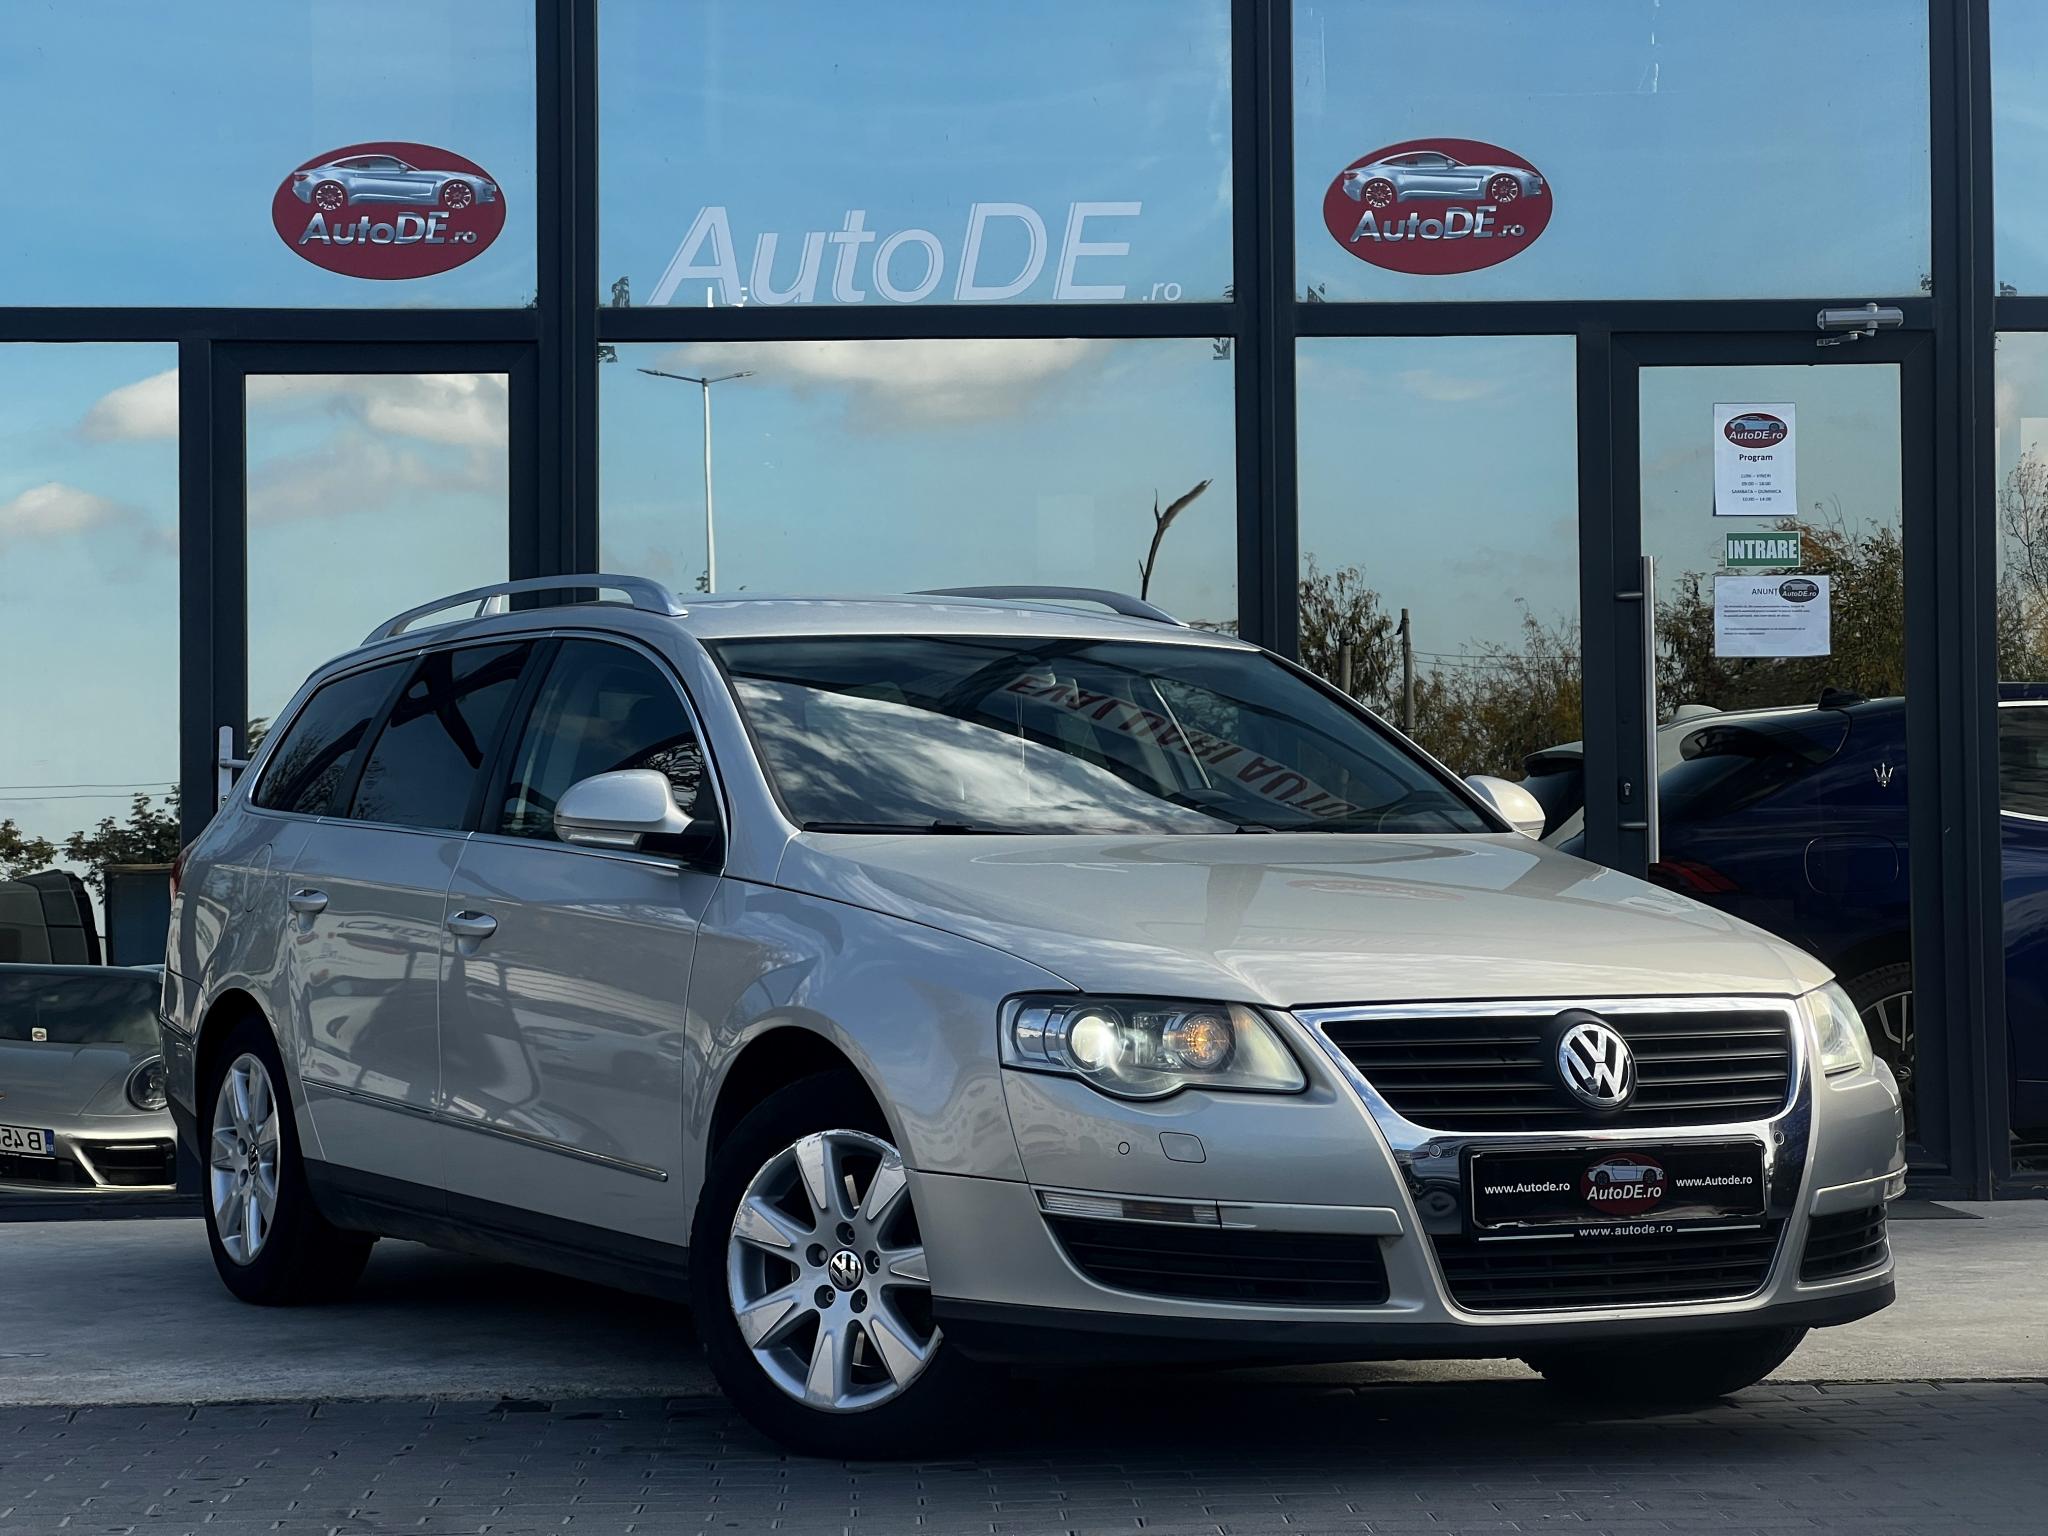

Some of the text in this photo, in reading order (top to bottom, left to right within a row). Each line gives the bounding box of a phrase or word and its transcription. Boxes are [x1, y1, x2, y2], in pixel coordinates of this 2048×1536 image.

[1729, 431, 1783, 439] AutoDE.ro
[1739, 454, 1773, 462] Program
[1728, 540, 1797, 559] INTRARE
[1676, 1175, 1753, 1187] www.Autode.ro
[1485, 1182, 1570, 1195] www.Autode.ro
[1587, 1185, 1662, 1201] AutoDE.ro
[1579, 1224, 1673, 1237] www.autode.ro
